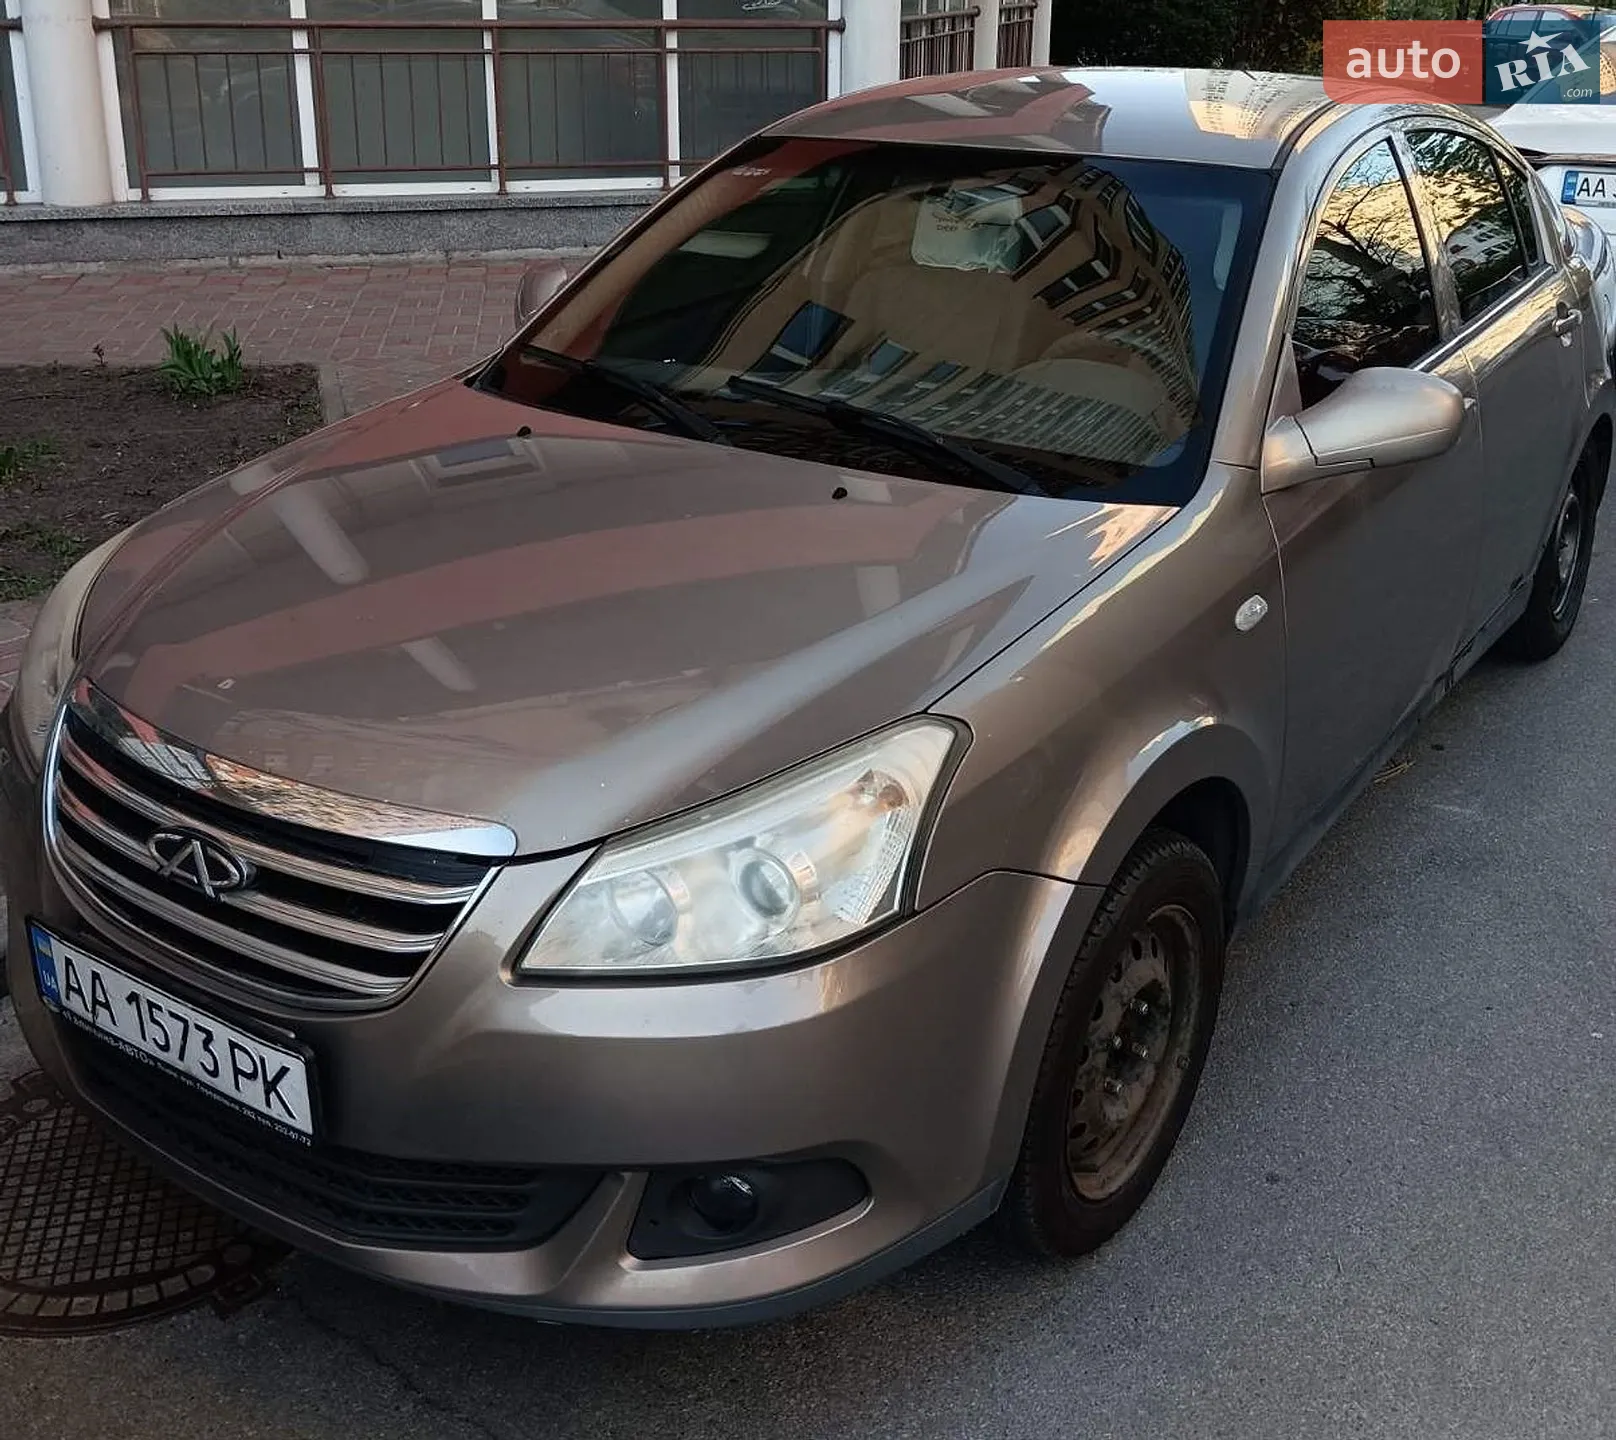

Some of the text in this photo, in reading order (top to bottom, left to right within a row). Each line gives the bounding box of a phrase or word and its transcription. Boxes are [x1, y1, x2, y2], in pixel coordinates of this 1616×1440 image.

[1577, 177, 1606, 198] AA
[64, 955, 118, 1027] AA
[126, 990, 221, 1079] 1573
[228, 1037, 297, 1120] PK
